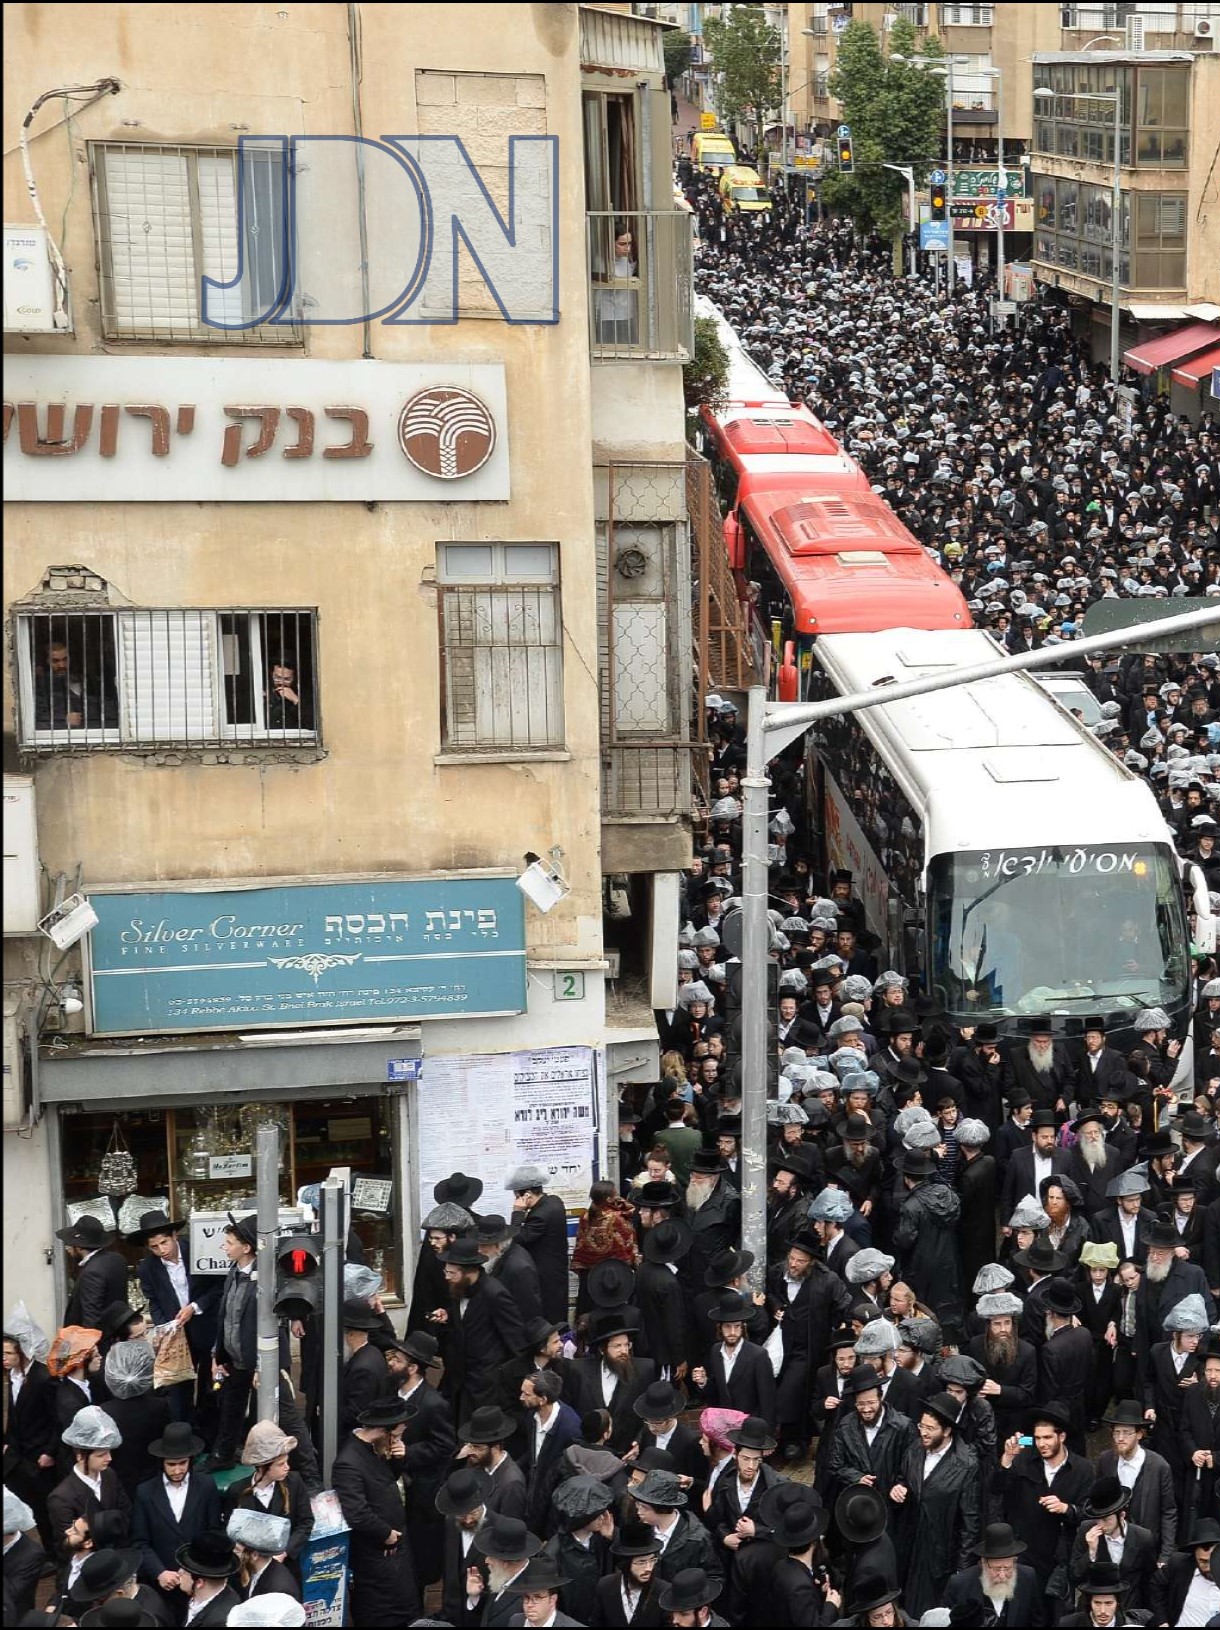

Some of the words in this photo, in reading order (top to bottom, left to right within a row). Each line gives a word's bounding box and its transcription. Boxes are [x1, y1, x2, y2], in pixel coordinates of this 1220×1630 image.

[3, 402, 197, 457] ירוש
[221, 403, 374, 466] בנק
[120, 918, 204, 944] Silver
[210, 915, 304, 939] Corner
[325, 911, 409, 938] הכסף
[425, 909, 497, 931] פינת
[122, 946, 167, 955] FINE
[182, 938, 305, 953] SILVERWARE
[563, 975, 576, 996] 2
